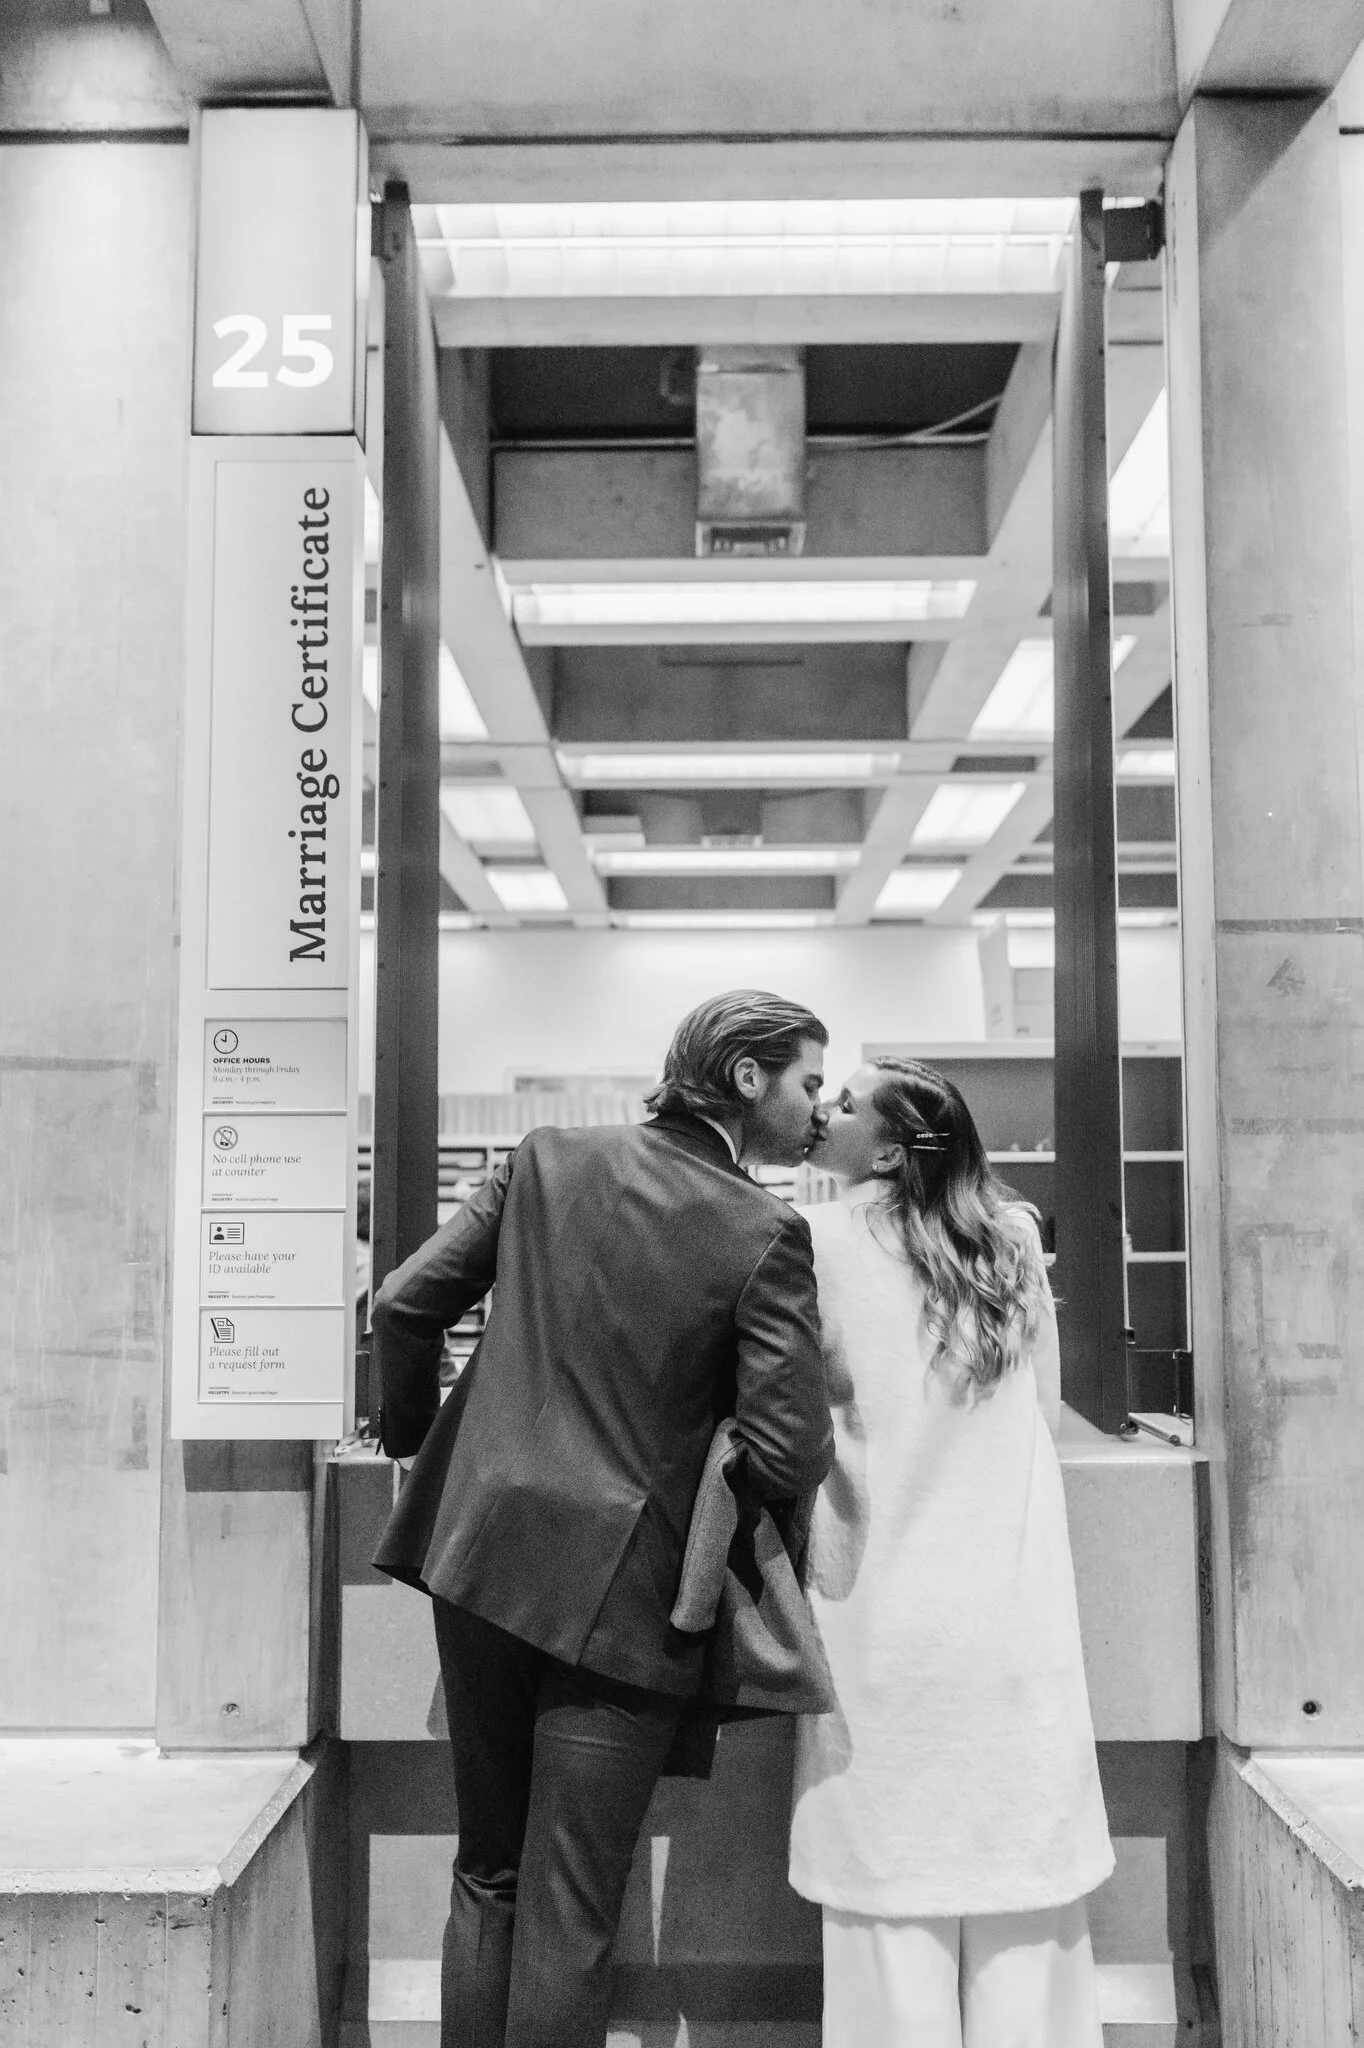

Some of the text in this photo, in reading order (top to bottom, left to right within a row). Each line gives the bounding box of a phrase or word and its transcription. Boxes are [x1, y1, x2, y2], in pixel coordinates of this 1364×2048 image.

[212, 314, 334, 388] 25
[288, 487, 340, 963] Marriage Certificate
[212, 1066, 301, 1074] Monday through Friday
[213, 1153, 302, 1166] No cell phone use
[212, 1168, 267, 1176] at counter
[209, 1251, 297, 1263] Please have your
[208, 1263, 272, 1274] ID available
[209, 1346, 280, 1359] Please fill out
[208, 1360, 285, 1372] a request form
